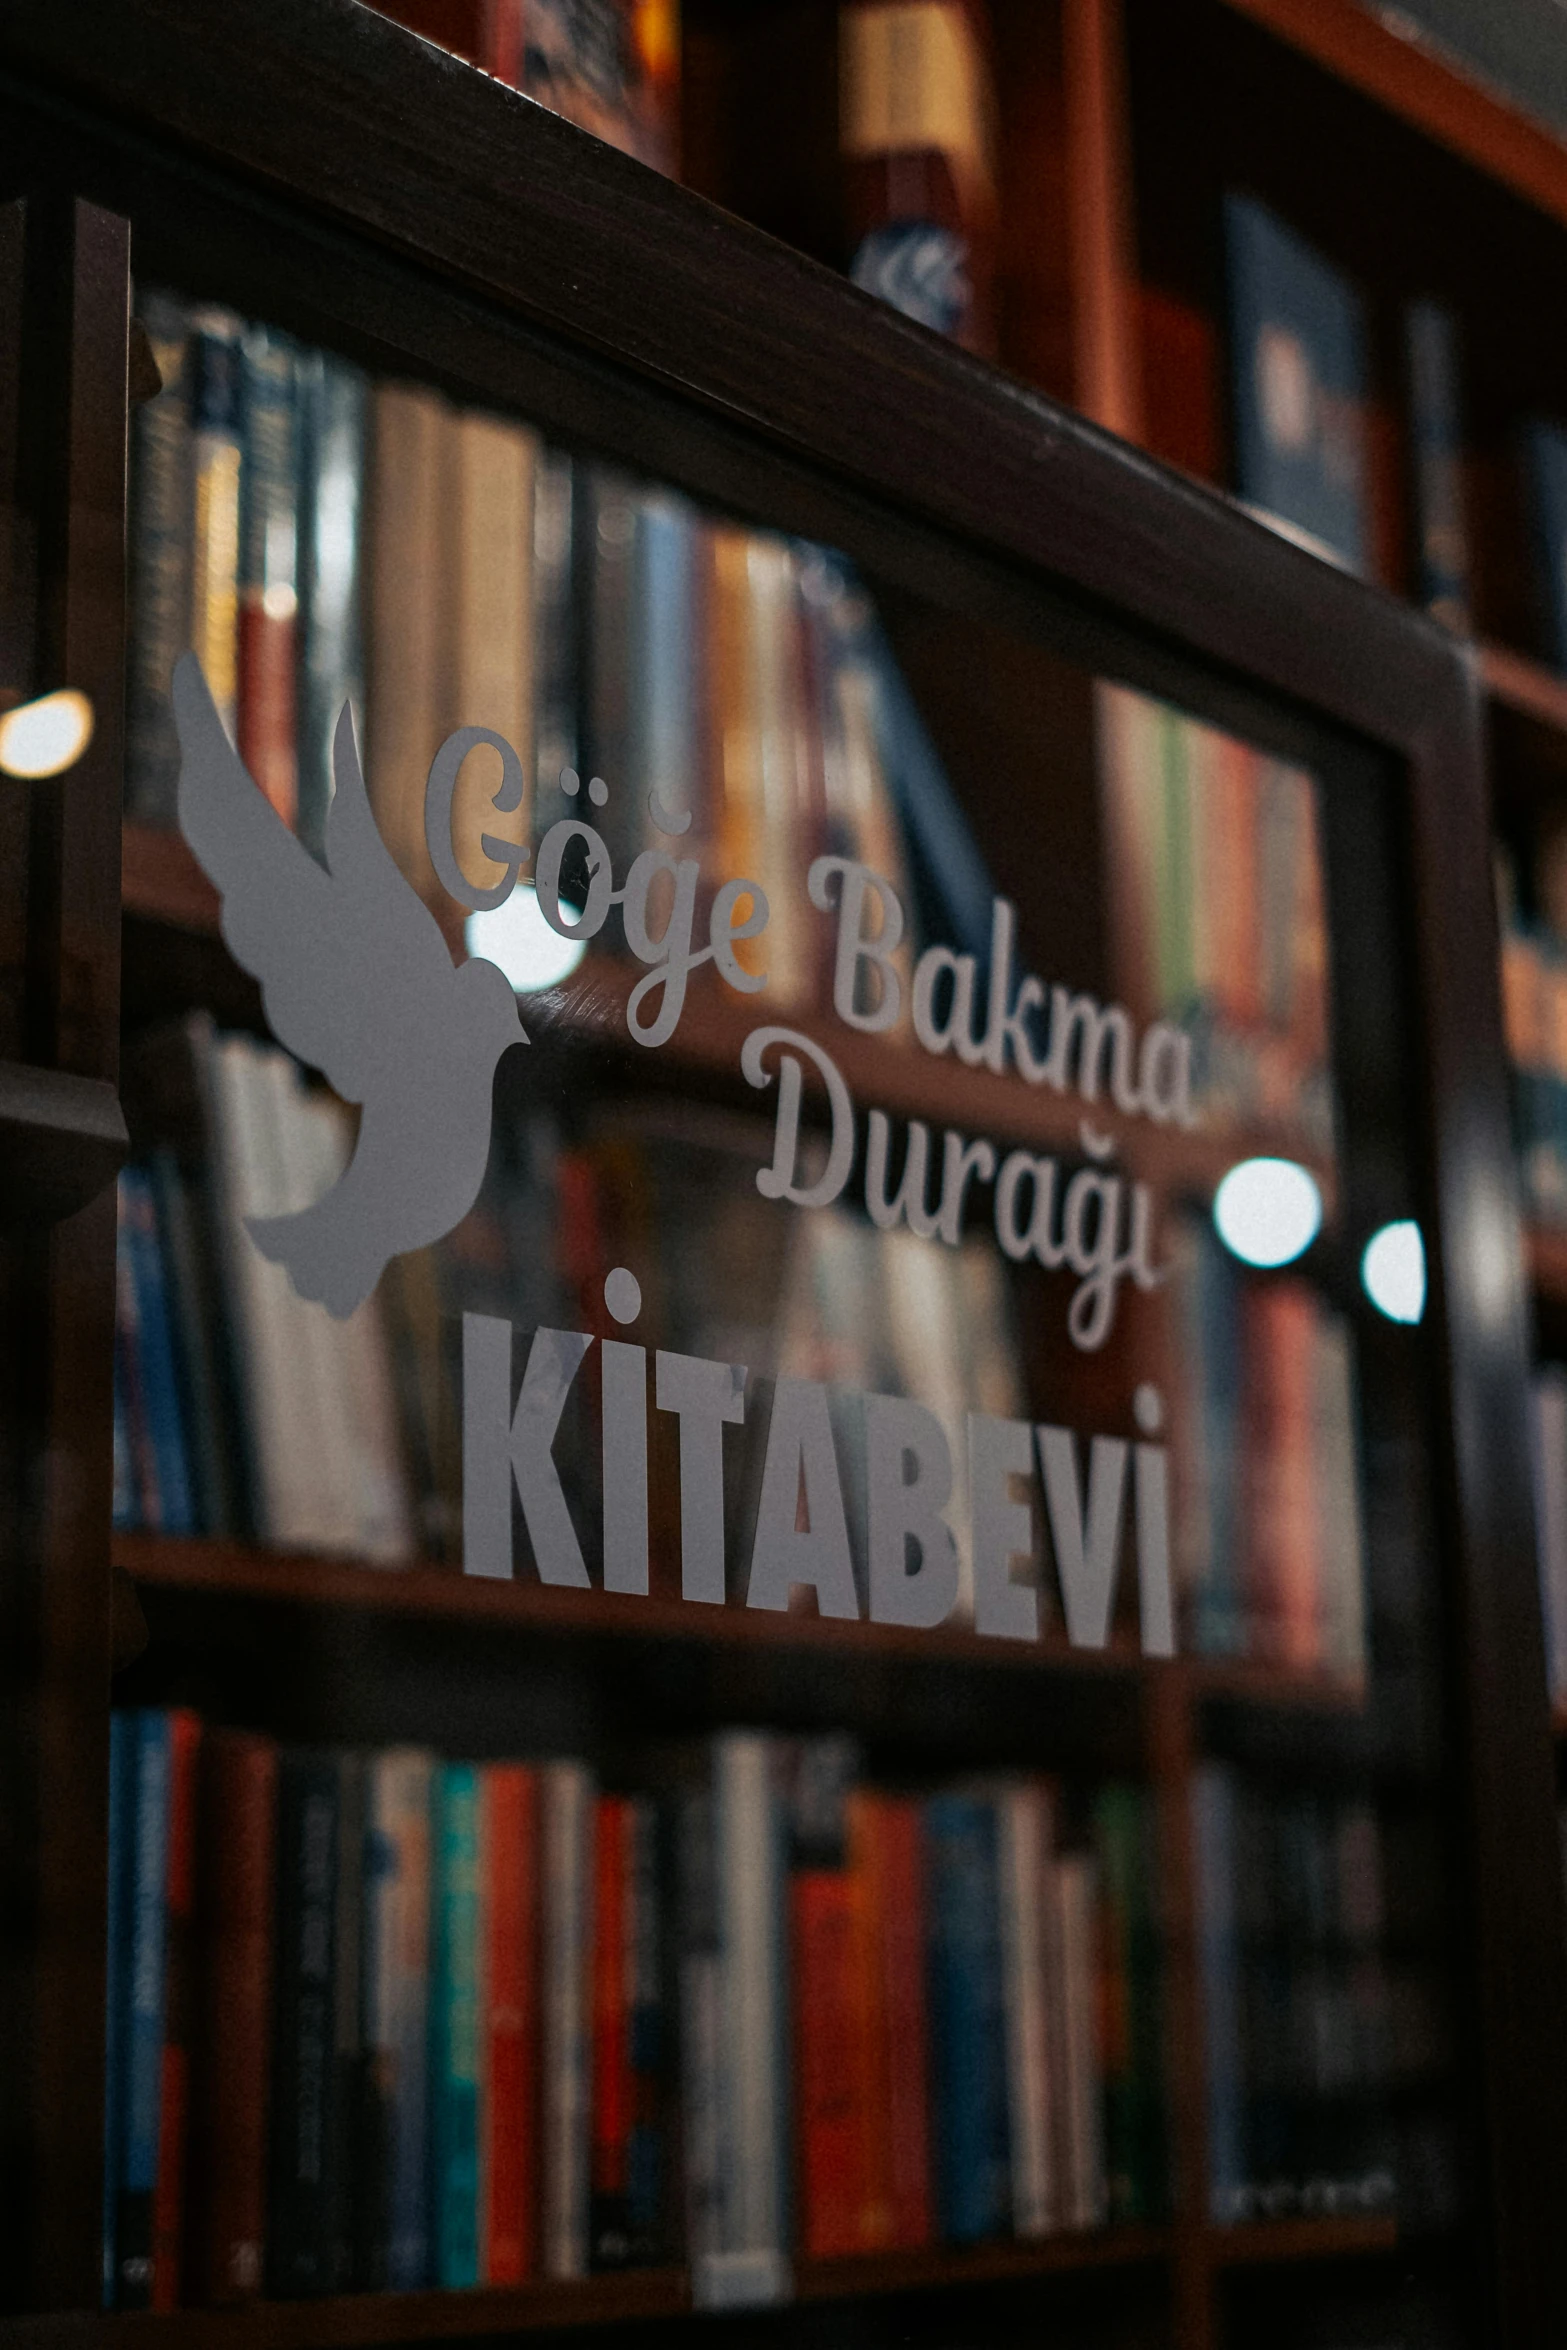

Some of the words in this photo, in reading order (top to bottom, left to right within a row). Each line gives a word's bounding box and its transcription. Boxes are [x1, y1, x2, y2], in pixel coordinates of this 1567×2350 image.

[425, 726, 769, 1047] Göğe
[807, 855, 1202, 1130] Bakma
[741, 1026, 1168, 1353] Durağı
[462, 1266, 1178, 1660] KİTABEVİ
